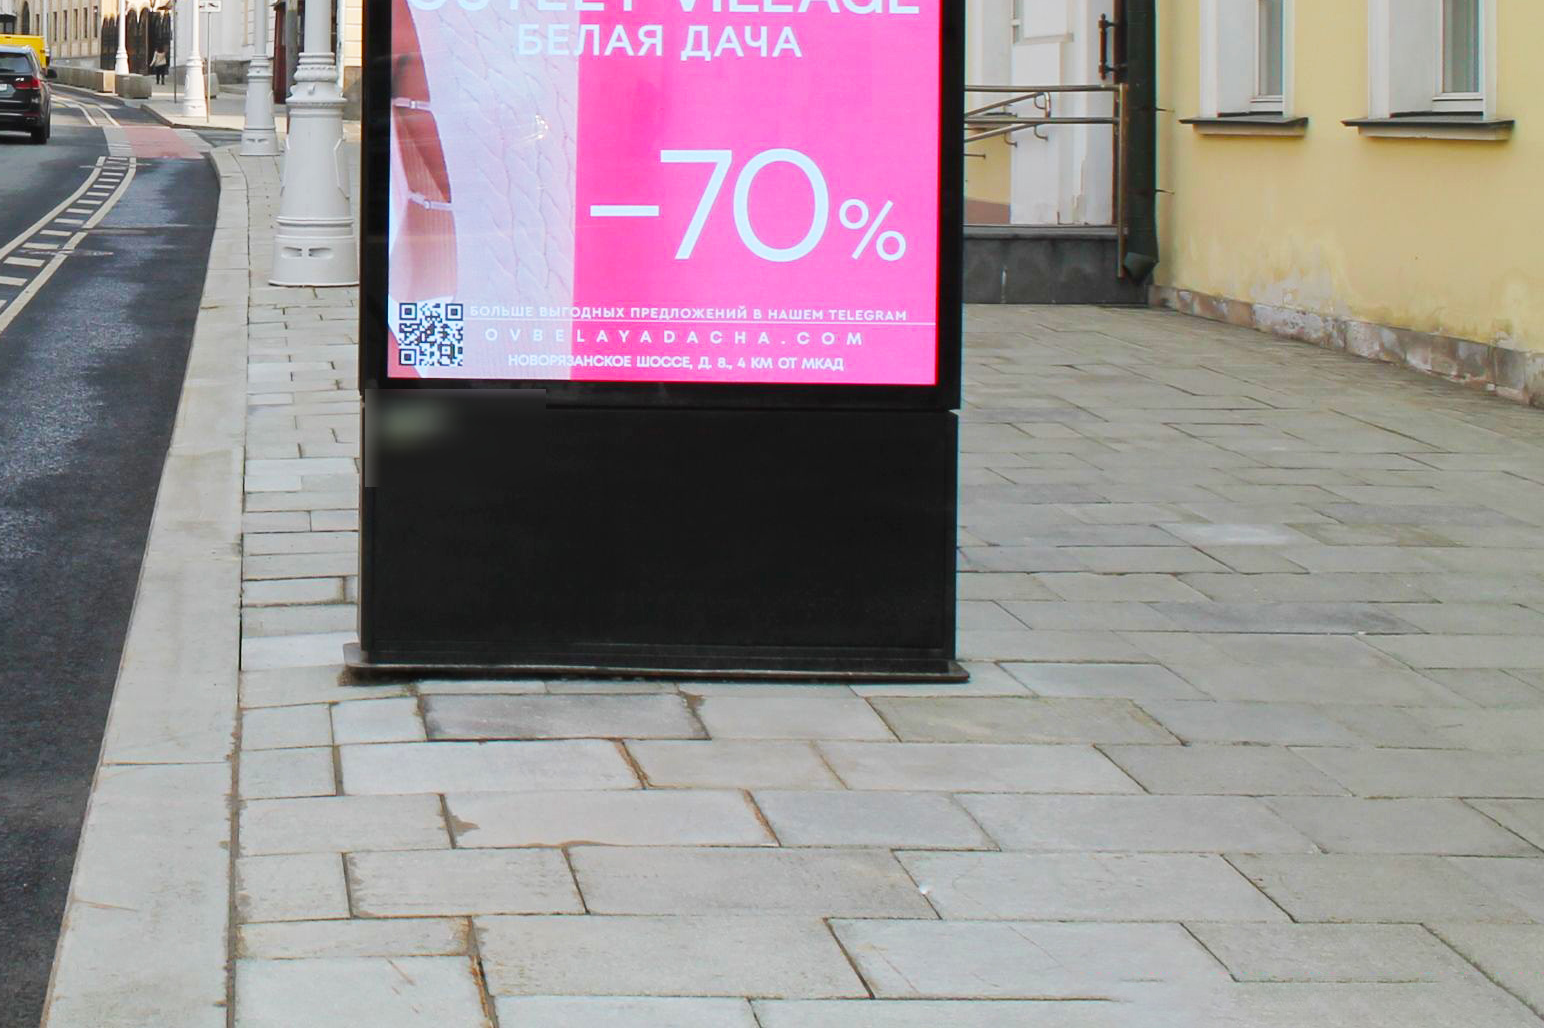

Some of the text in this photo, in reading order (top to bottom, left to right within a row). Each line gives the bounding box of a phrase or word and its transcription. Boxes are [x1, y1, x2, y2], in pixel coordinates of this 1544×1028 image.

[518, 23, 803, 62] БЕЛАЯ ДАЧА
[470, 306, 908, 322] БОЛЬШЕ ВЫГОДНЫХ ПРЕДЛОЖЕНИЙ В НАШЕМ TELEGRAM
[508, 354, 632, 368] НОВОРЯЗАНСКОЕ
[737, 357, 746, 369] 4
[751, 357, 774, 370] КМ
[778, 358, 797, 370] ОТ
[801, 358, 845, 372] МКАД
